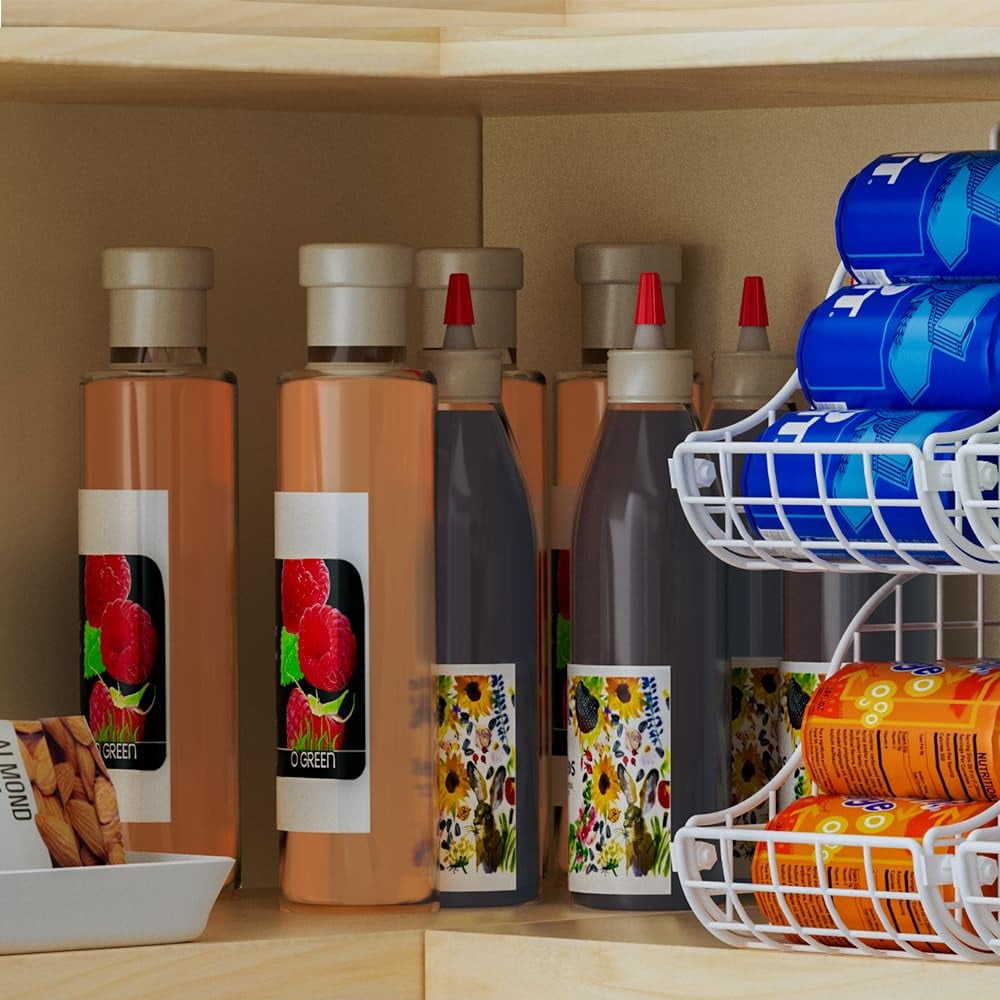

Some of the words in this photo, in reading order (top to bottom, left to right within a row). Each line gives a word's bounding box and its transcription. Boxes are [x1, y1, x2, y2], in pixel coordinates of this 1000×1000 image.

[102, 744, 138, 760] GREEN
[290, 751, 298, 768] O
[300, 752, 336, 769] GREEN
